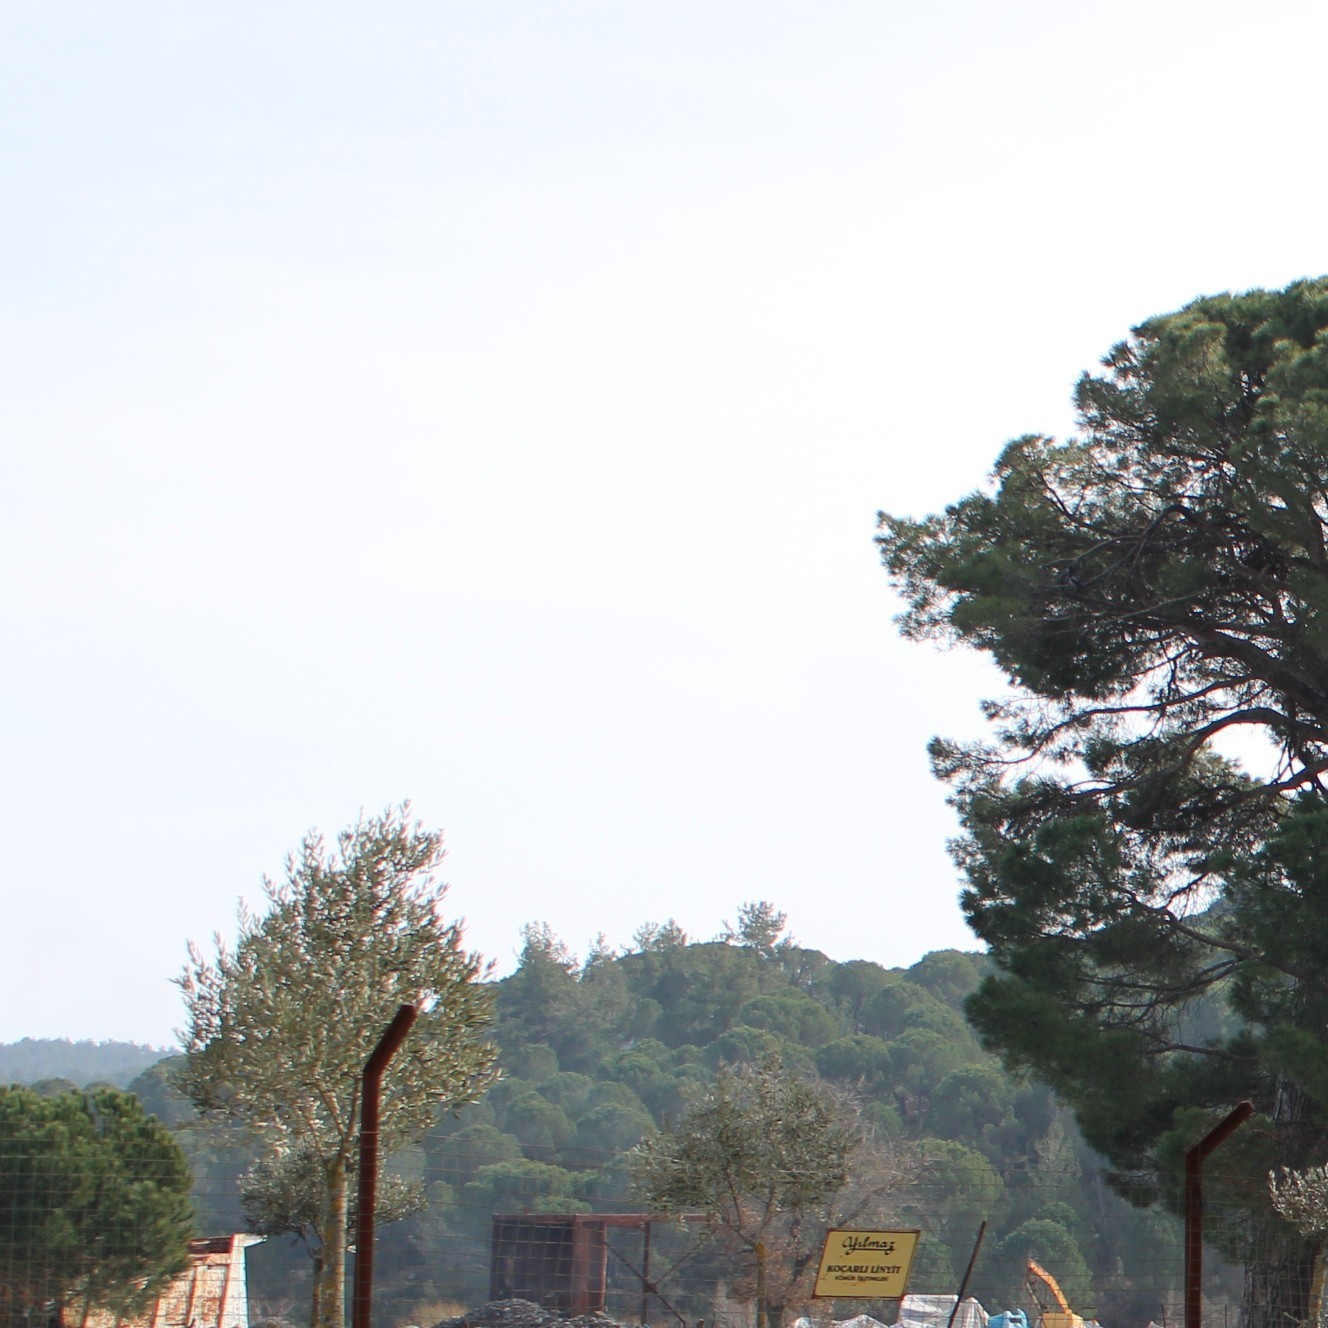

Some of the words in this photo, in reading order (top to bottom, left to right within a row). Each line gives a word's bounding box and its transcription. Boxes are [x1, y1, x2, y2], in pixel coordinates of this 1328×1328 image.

[842, 1236, 896, 1255] Yılmaz
[827, 1265, 869, 1274] KOÇARLI
[870, 1264, 901, 1274] LİNYİT
